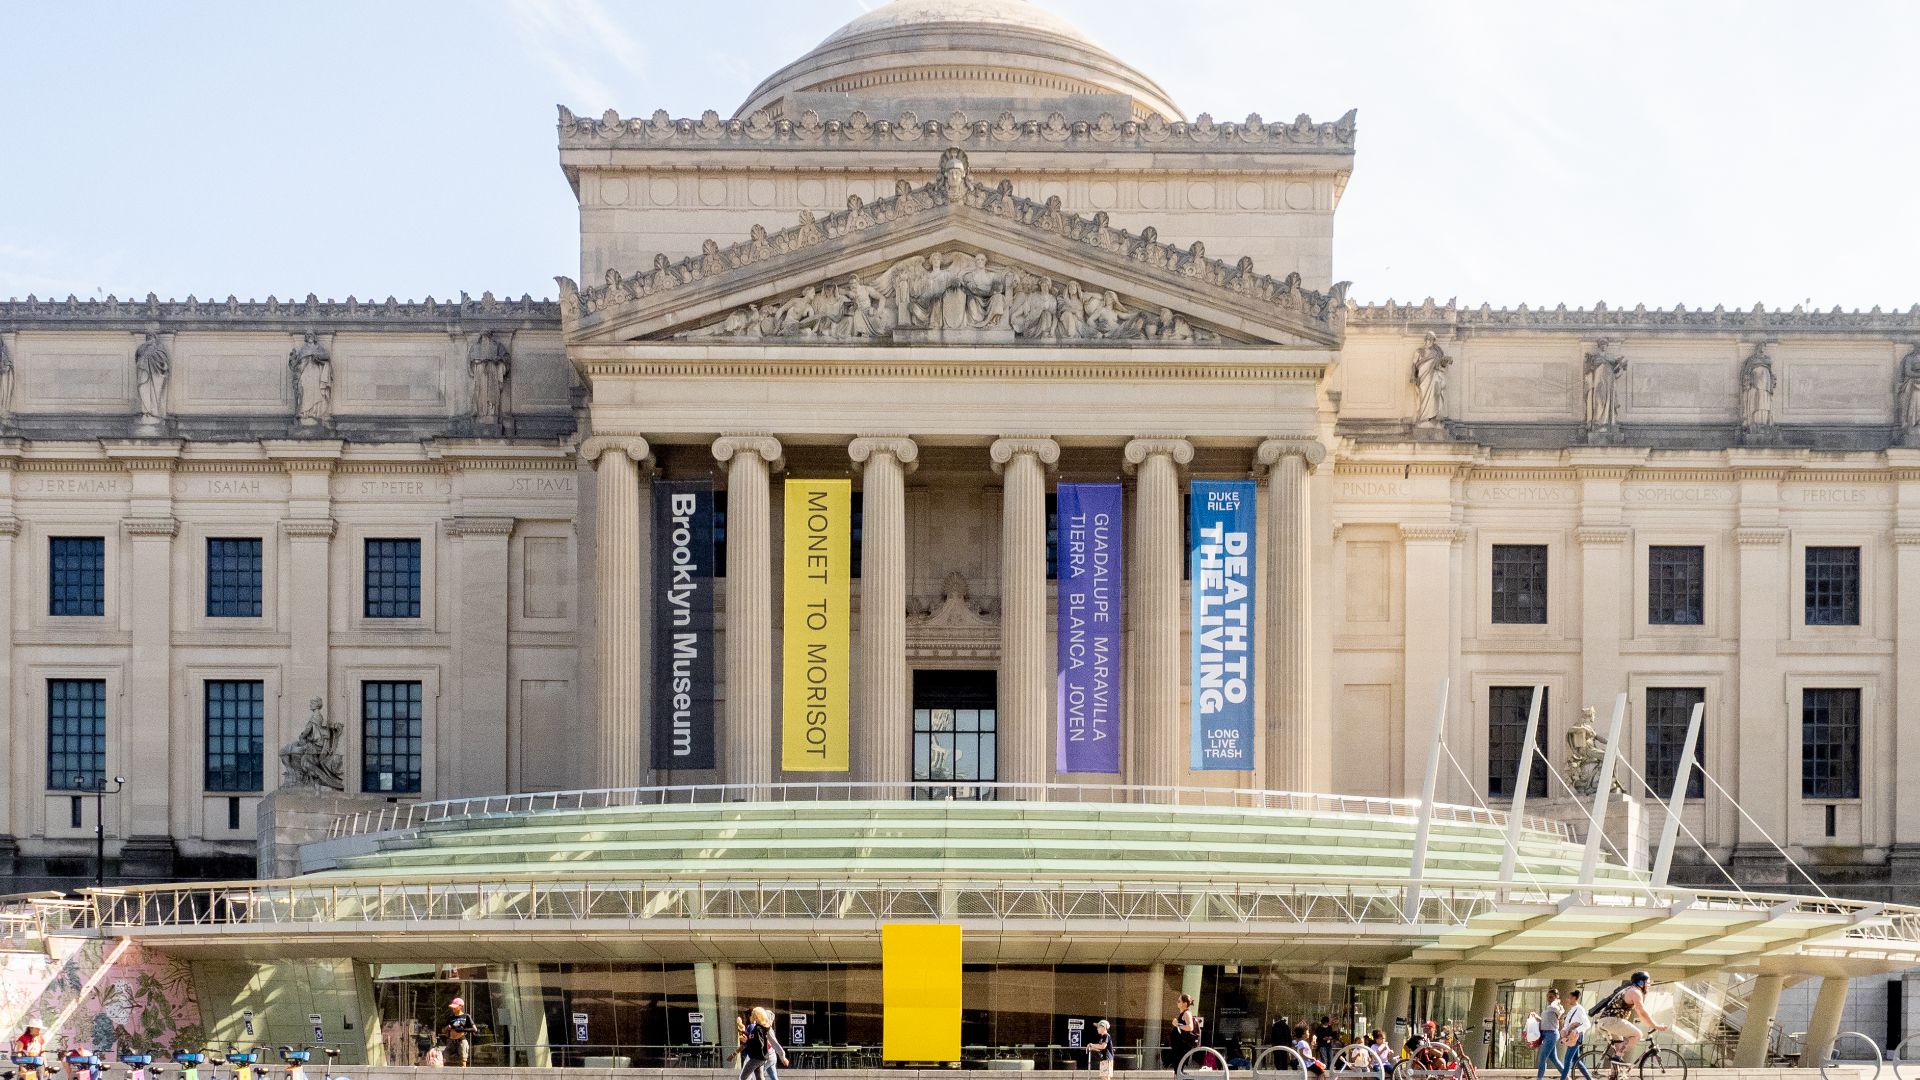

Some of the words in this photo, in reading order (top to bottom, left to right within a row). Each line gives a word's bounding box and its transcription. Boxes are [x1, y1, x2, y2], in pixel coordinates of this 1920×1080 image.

[35, 479, 116, 493] JEREMIAH
[207, 480, 260, 494] ISAIAH
[516, 478, 532, 491] ST
[537, 478, 573, 491] PAVL
[1208, 492, 1240, 501] DUKE
[1343, 482, 1397, 496] PINDAR
[1481, 487, 1559, 500] AESCHYLVS
[1638, 487, 1718, 501] SOPHOCLES
[1802, 488, 1866, 502] PERICLES
[1207, 502, 1241, 511] RILEY
[807, 491, 828, 585] MONET
[1070, 513, 1086, 578] TIERRA
[1200, 521, 1224, 590] THE
[667, 493, 697, 626] Brooklyn
[1093, 513, 1109, 622] GUADALUPE
[1224, 532, 1248, 651] DEATH
[807, 598, 827, 631] TO
[1070, 593, 1085, 670] BLANCA
[1200, 595, 1224, 713] LIVING
[672, 633, 697, 756] Museum
[1092, 637, 1109, 742] MARAVILLA
[1224, 656, 1247, 704] TO
[806, 644, 827, 759] MORISOT
[1069, 682, 1085, 742] JOVEN
[1204, 749, 1242, 758] TRASH
[1207, 729, 1240, 739] LONG
[1211, 739, 1237, 748] LIVE
